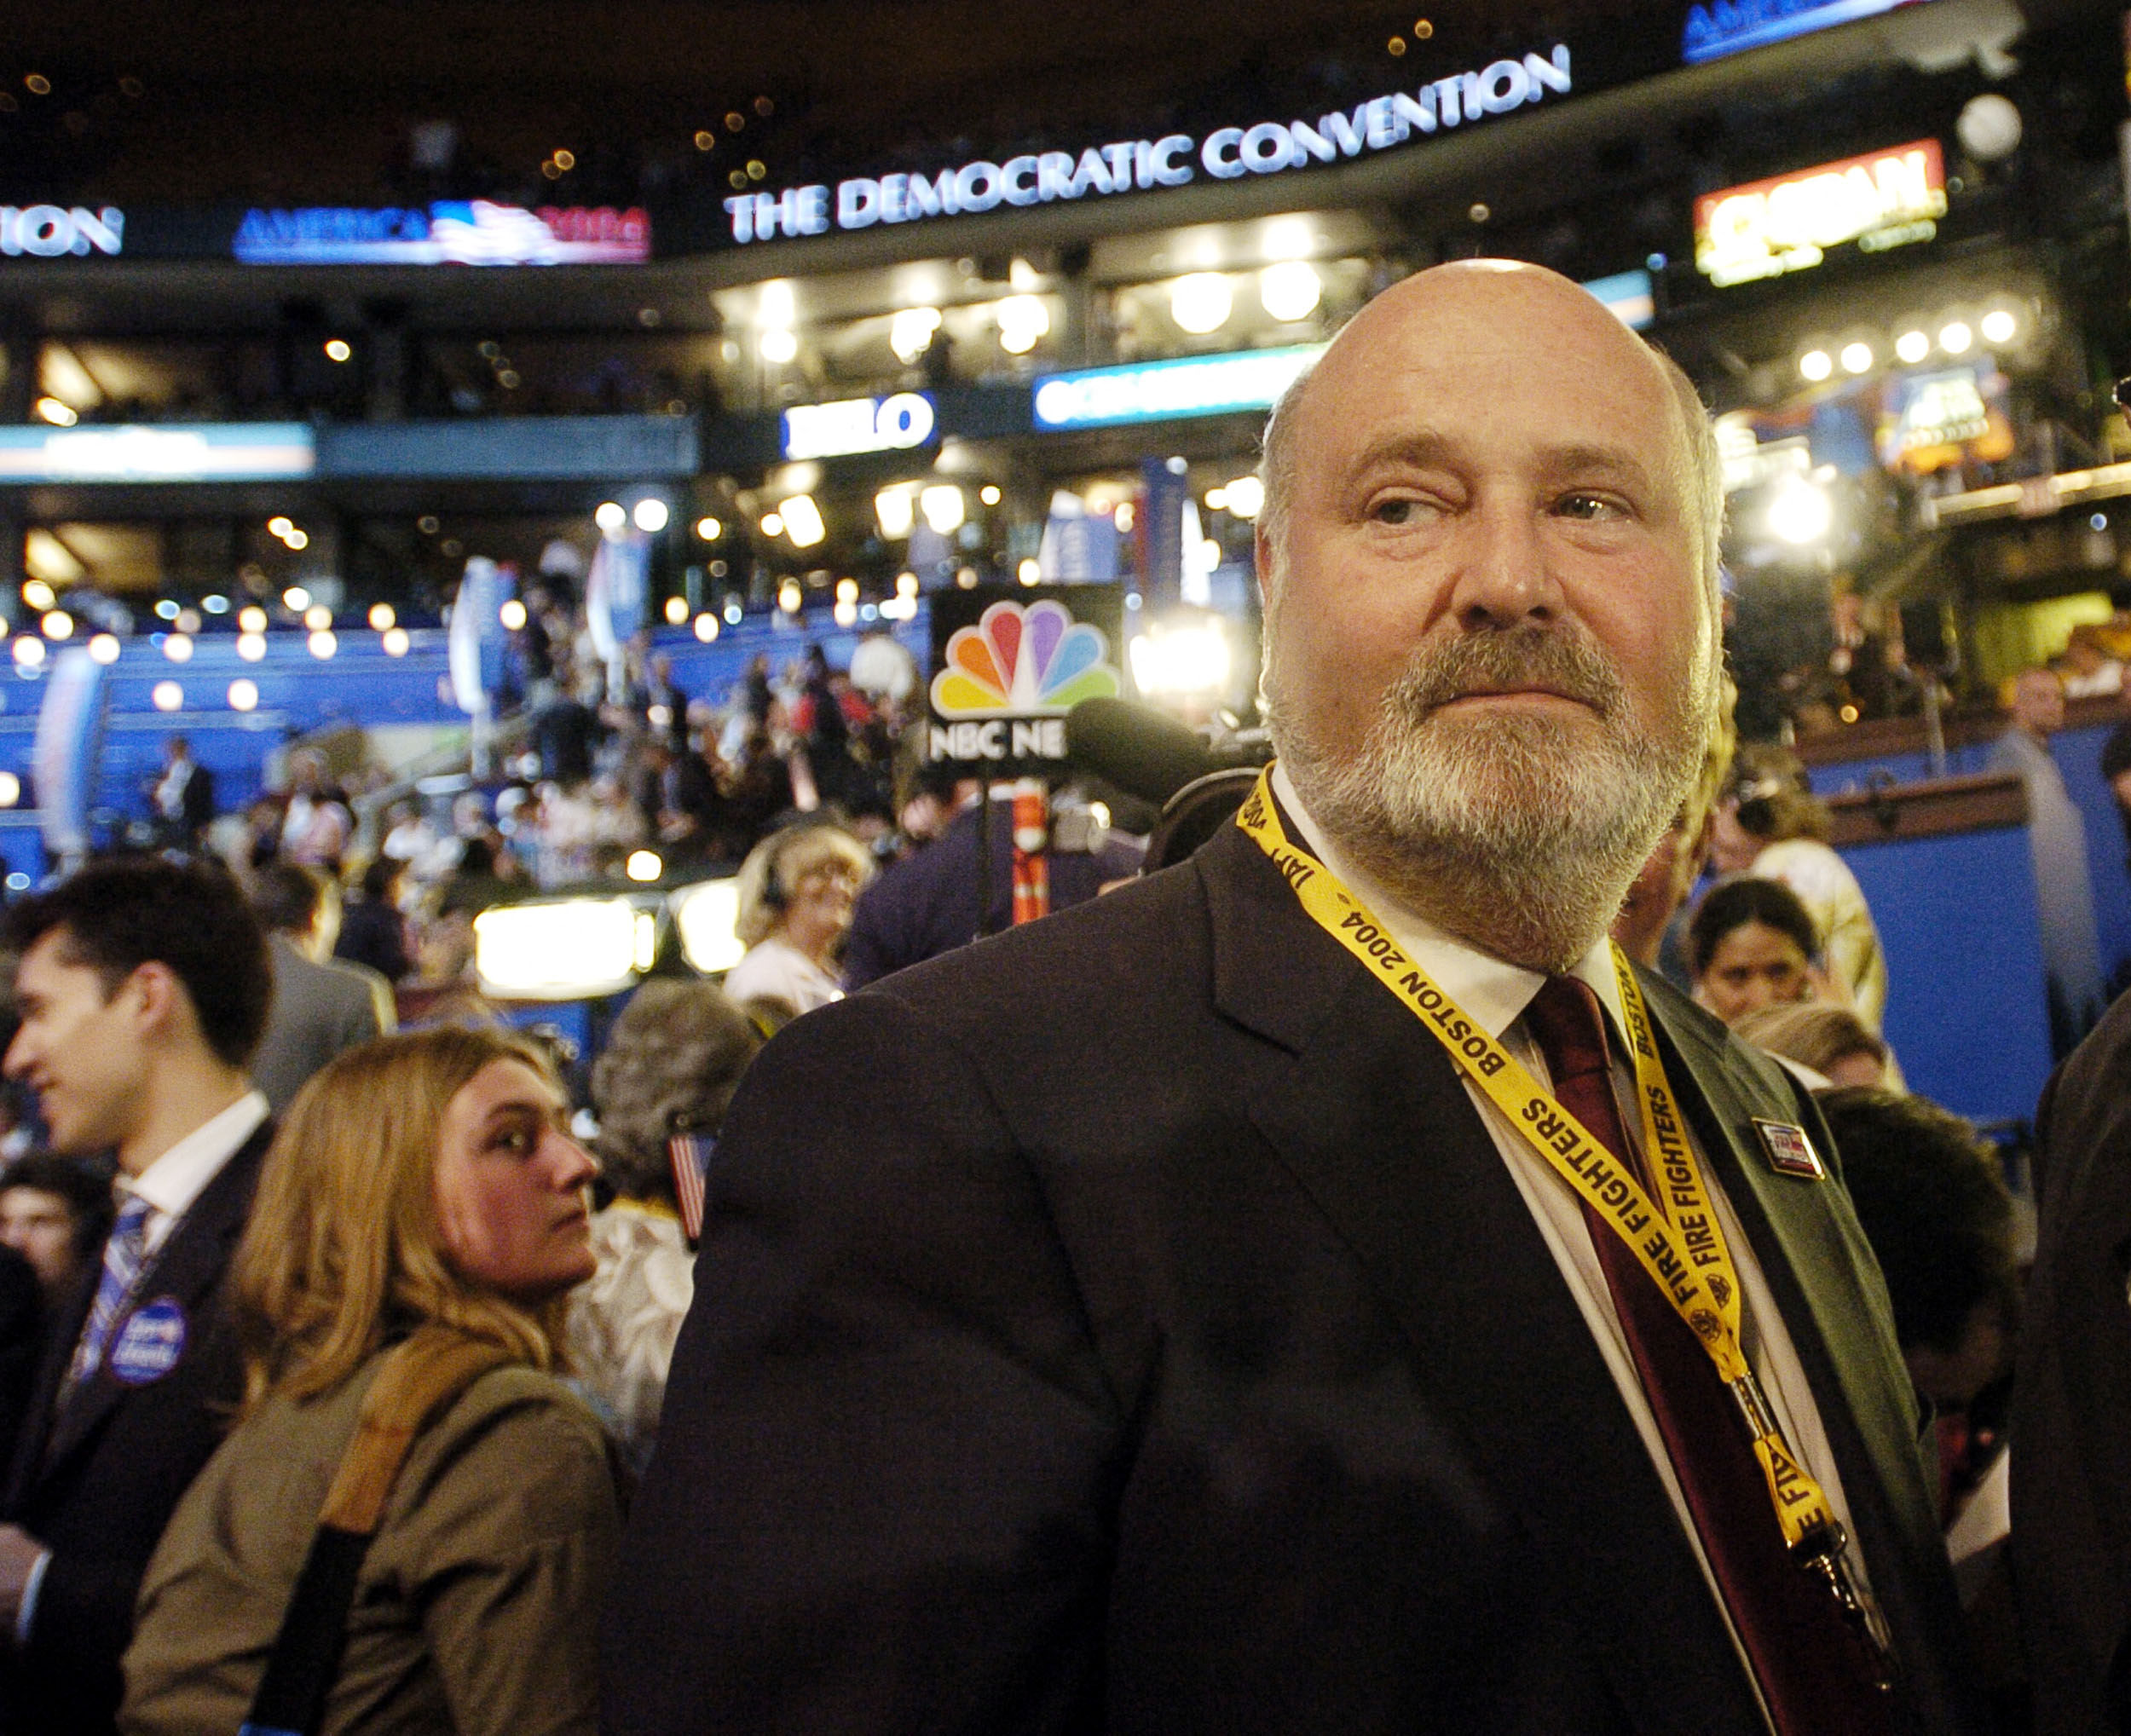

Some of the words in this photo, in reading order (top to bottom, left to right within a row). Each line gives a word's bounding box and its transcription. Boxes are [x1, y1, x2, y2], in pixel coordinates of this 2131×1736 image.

[724, 185, 829, 244] THE
[837, 134, 1193, 229] DEMOCRATIC
[1201, 44, 1572, 179] CONVENTION
[0, 205, 125, 257] ION
[930, 721, 1007, 762] NBC
[1012, 718, 1066, 759] NE
[1340, 911, 1406, 970] 2004
[1399, 971, 1506, 1077] BOSTON
[1522, 1098, 1651, 1234] FIGHTERS
[1646, 1084, 1701, 1208] FIGHTERS
[1643, 1231, 1699, 1306] FIRE
[1679, 1213, 1720, 1268] FIRE
